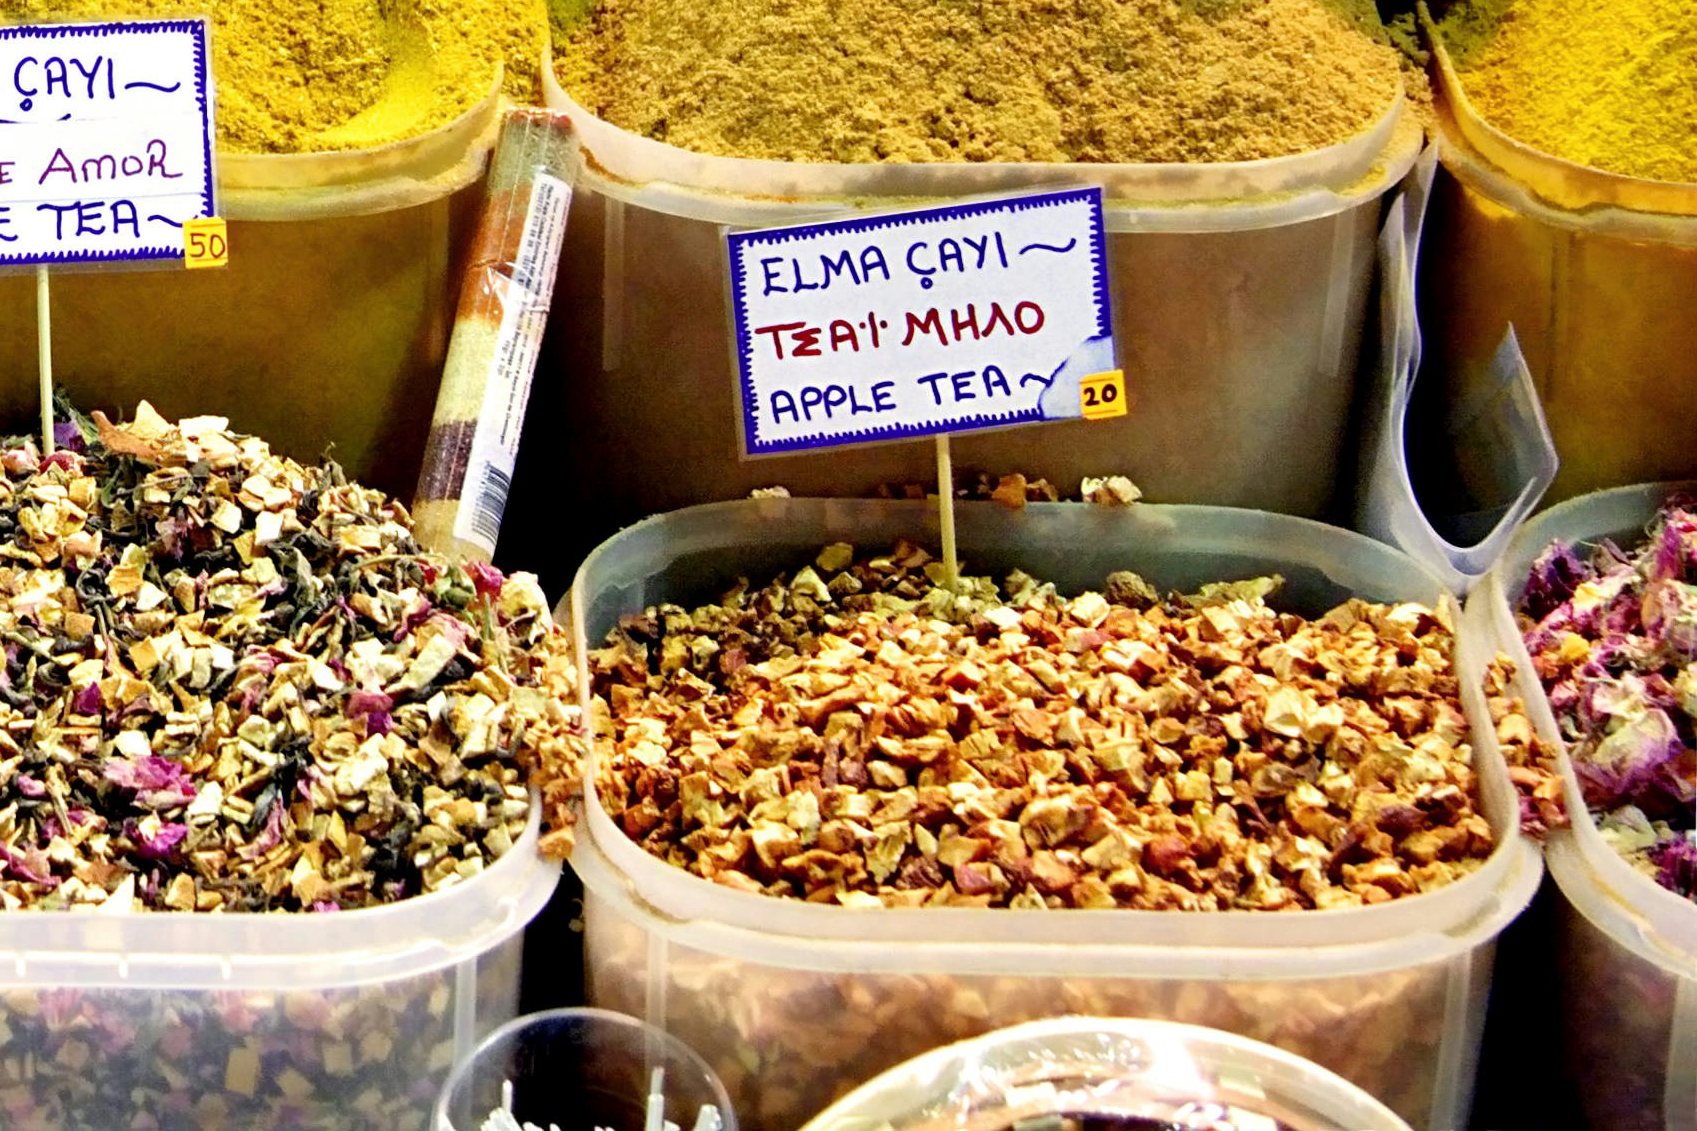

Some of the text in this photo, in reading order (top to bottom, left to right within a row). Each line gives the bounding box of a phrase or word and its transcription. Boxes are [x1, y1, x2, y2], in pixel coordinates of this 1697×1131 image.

[13, 55, 116, 111] ÇAYI
[36, 199, 141, 241] TEA
[188, 232, 226, 260] 50
[759, 231, 1009, 297] ELMA ÇAYI
[901, 300, 1046, 348] ΜΗΛΟ
[769, 364, 1011, 426] APPLE TEA
[1083, 383, 1118, 407] 20
